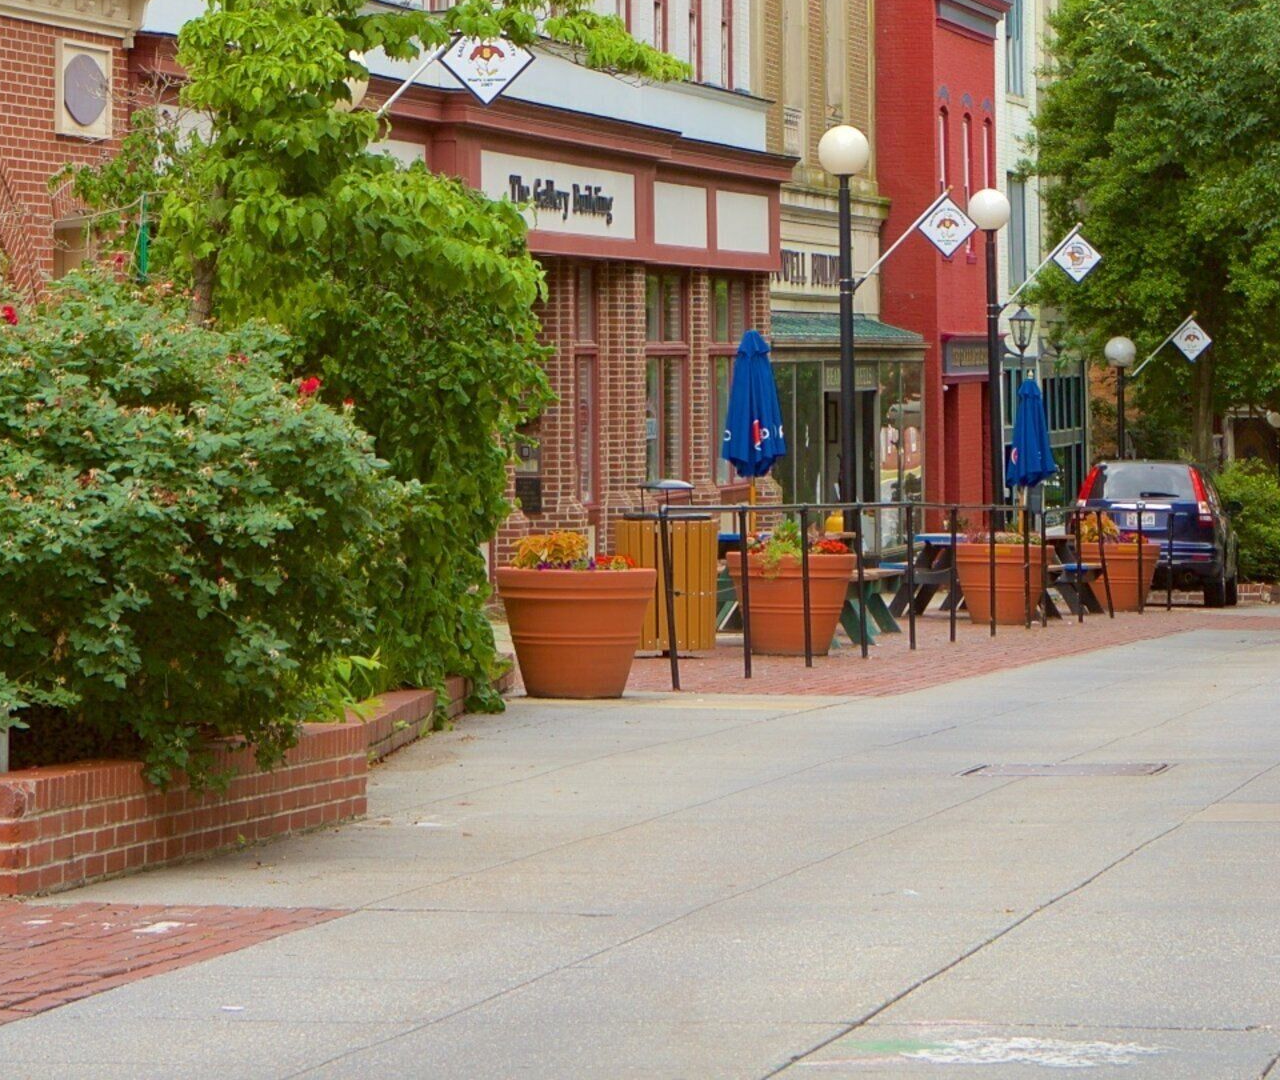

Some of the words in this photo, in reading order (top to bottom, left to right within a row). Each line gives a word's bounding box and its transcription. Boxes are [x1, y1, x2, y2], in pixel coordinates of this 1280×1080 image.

[509, 174, 530, 204] The
[533, 178, 570, 221] Gallery
[572, 183, 614, 226] Building
